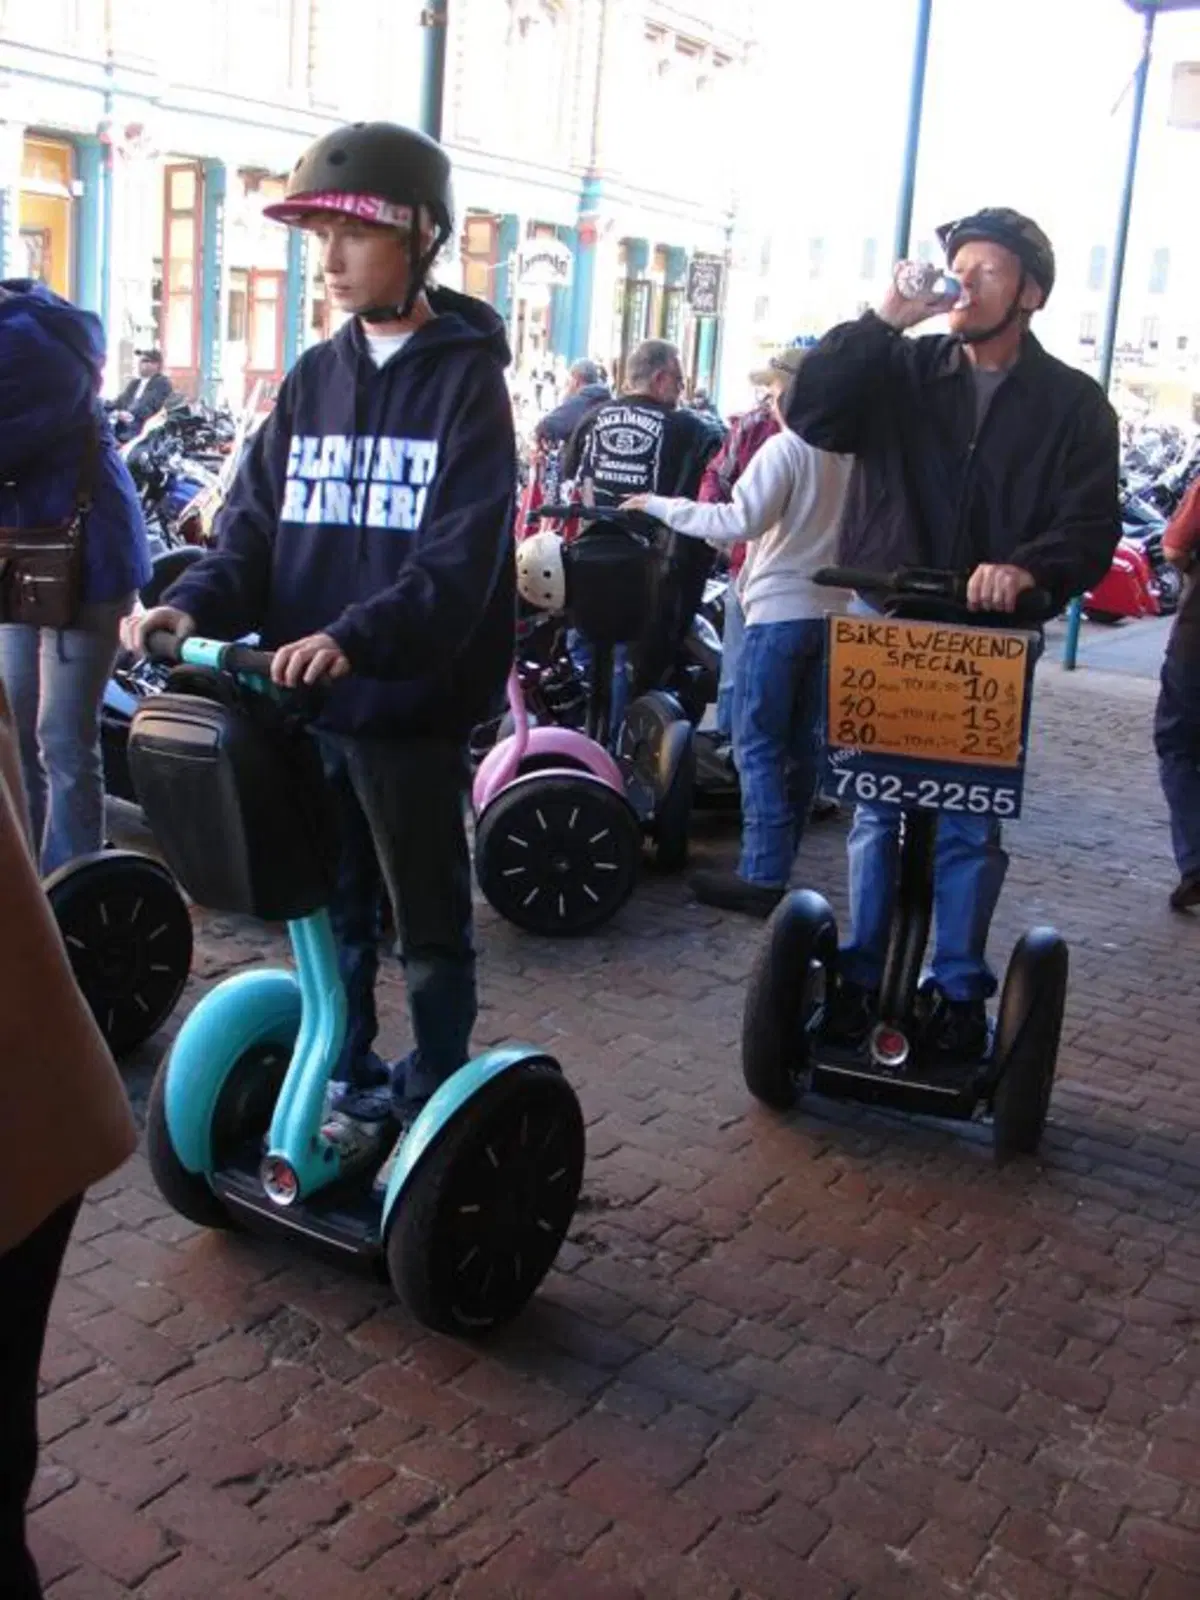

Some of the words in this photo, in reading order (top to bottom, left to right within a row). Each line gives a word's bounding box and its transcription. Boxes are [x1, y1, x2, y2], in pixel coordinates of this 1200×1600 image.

[906, 629, 1025, 659] WEEKEND
[840, 667, 877, 690] 20
[839, 693, 876, 718] 40
[836, 719, 877, 745] 80
[832, 768, 1016, 815] 762-2255
